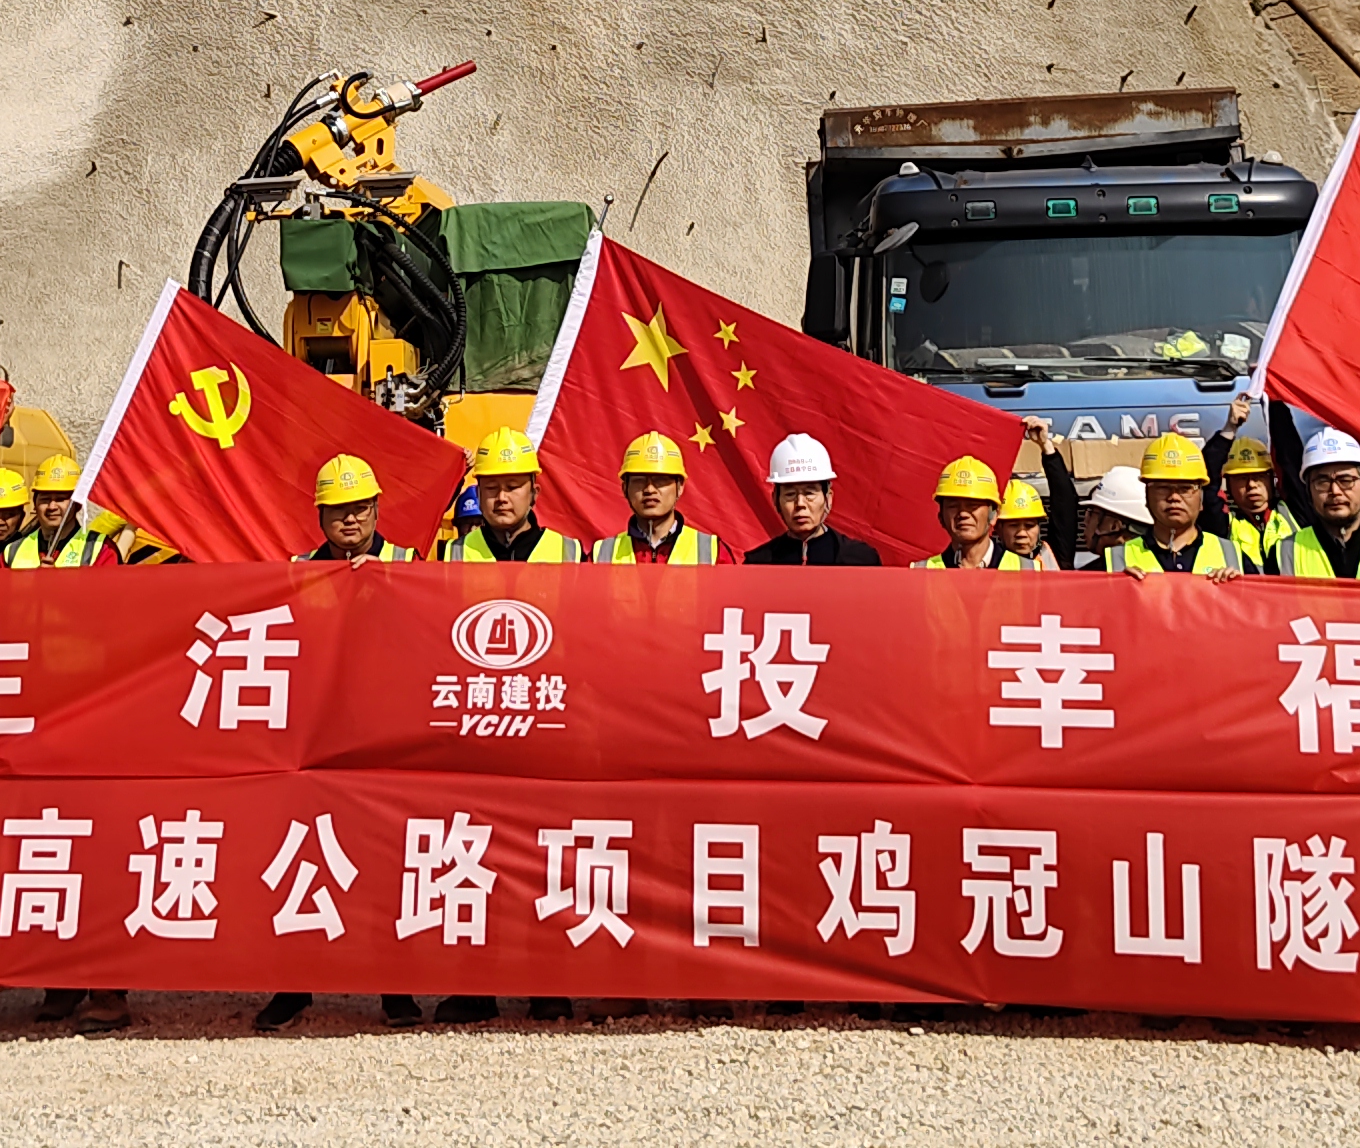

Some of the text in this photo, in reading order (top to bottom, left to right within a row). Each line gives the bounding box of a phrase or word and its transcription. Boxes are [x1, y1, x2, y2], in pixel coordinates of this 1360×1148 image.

[431, 673, 567, 711] 云南建投
[459, 714, 535, 737] YCIH
